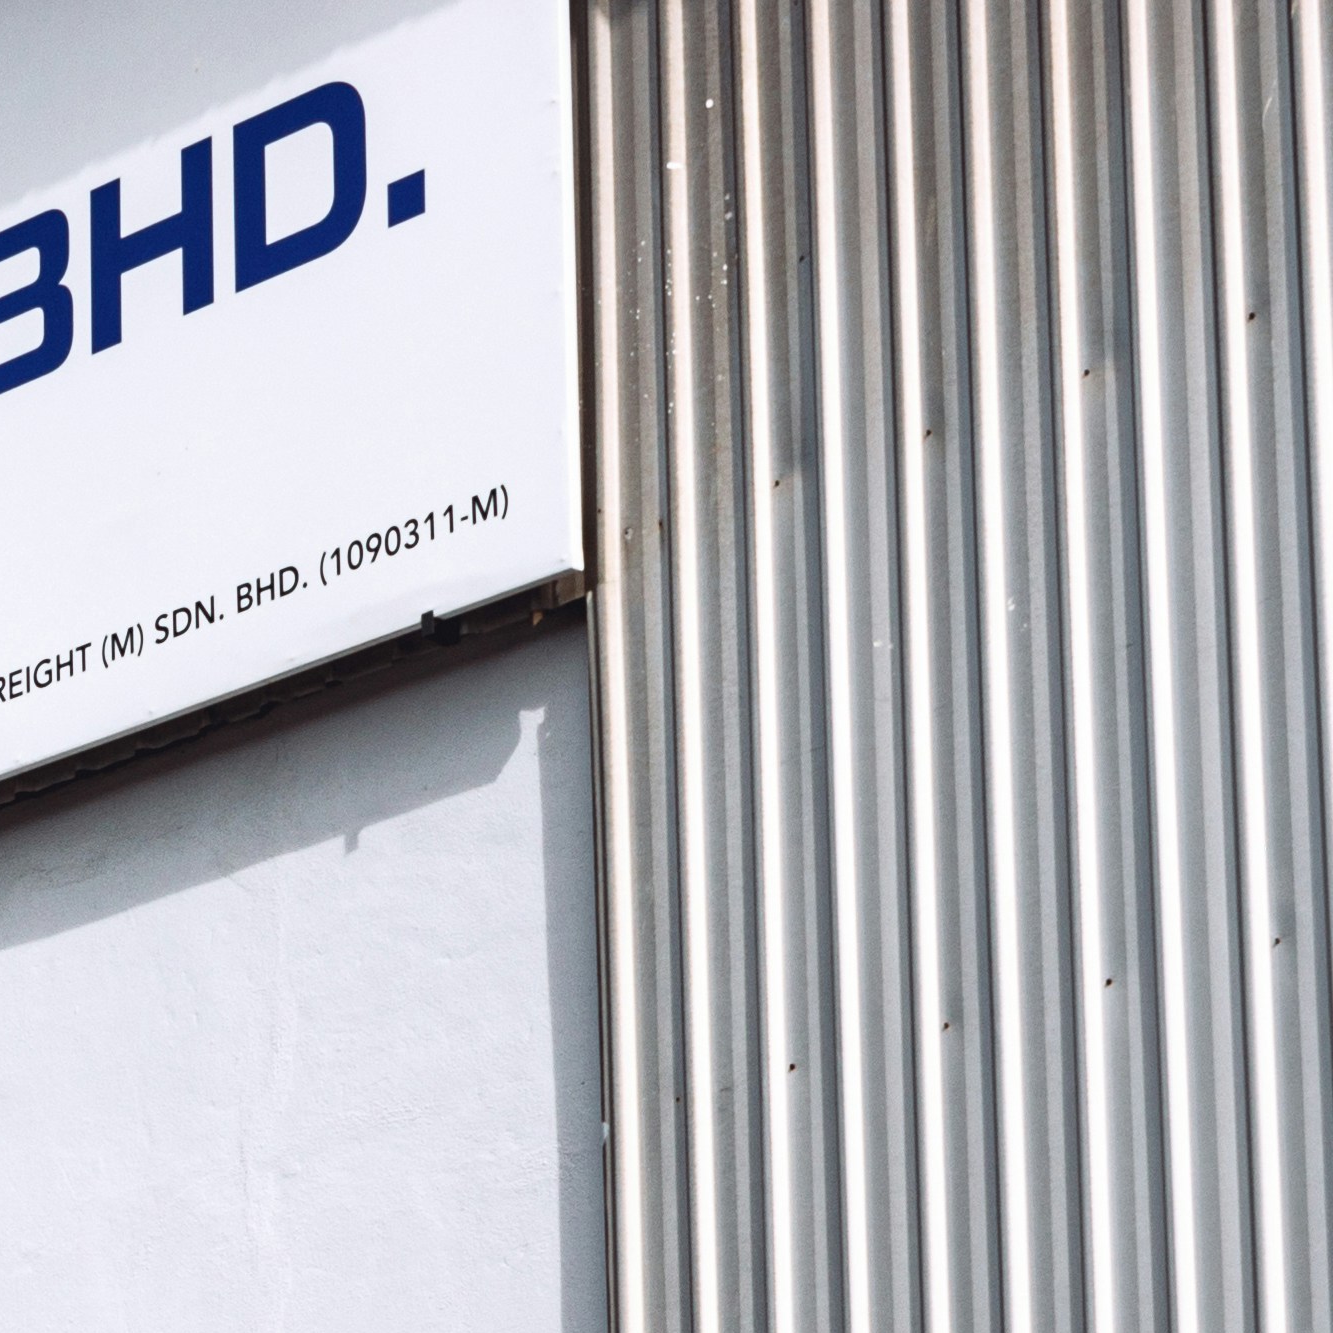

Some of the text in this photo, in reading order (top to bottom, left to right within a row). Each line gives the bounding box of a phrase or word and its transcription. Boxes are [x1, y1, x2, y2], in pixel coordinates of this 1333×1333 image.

[100, 622, 145, 669] (M)
[153, 595, 225, 645] SDN.
[235, 565, 309, 614] BHD.
[318, 484, 510, 586] (1090311-M)
